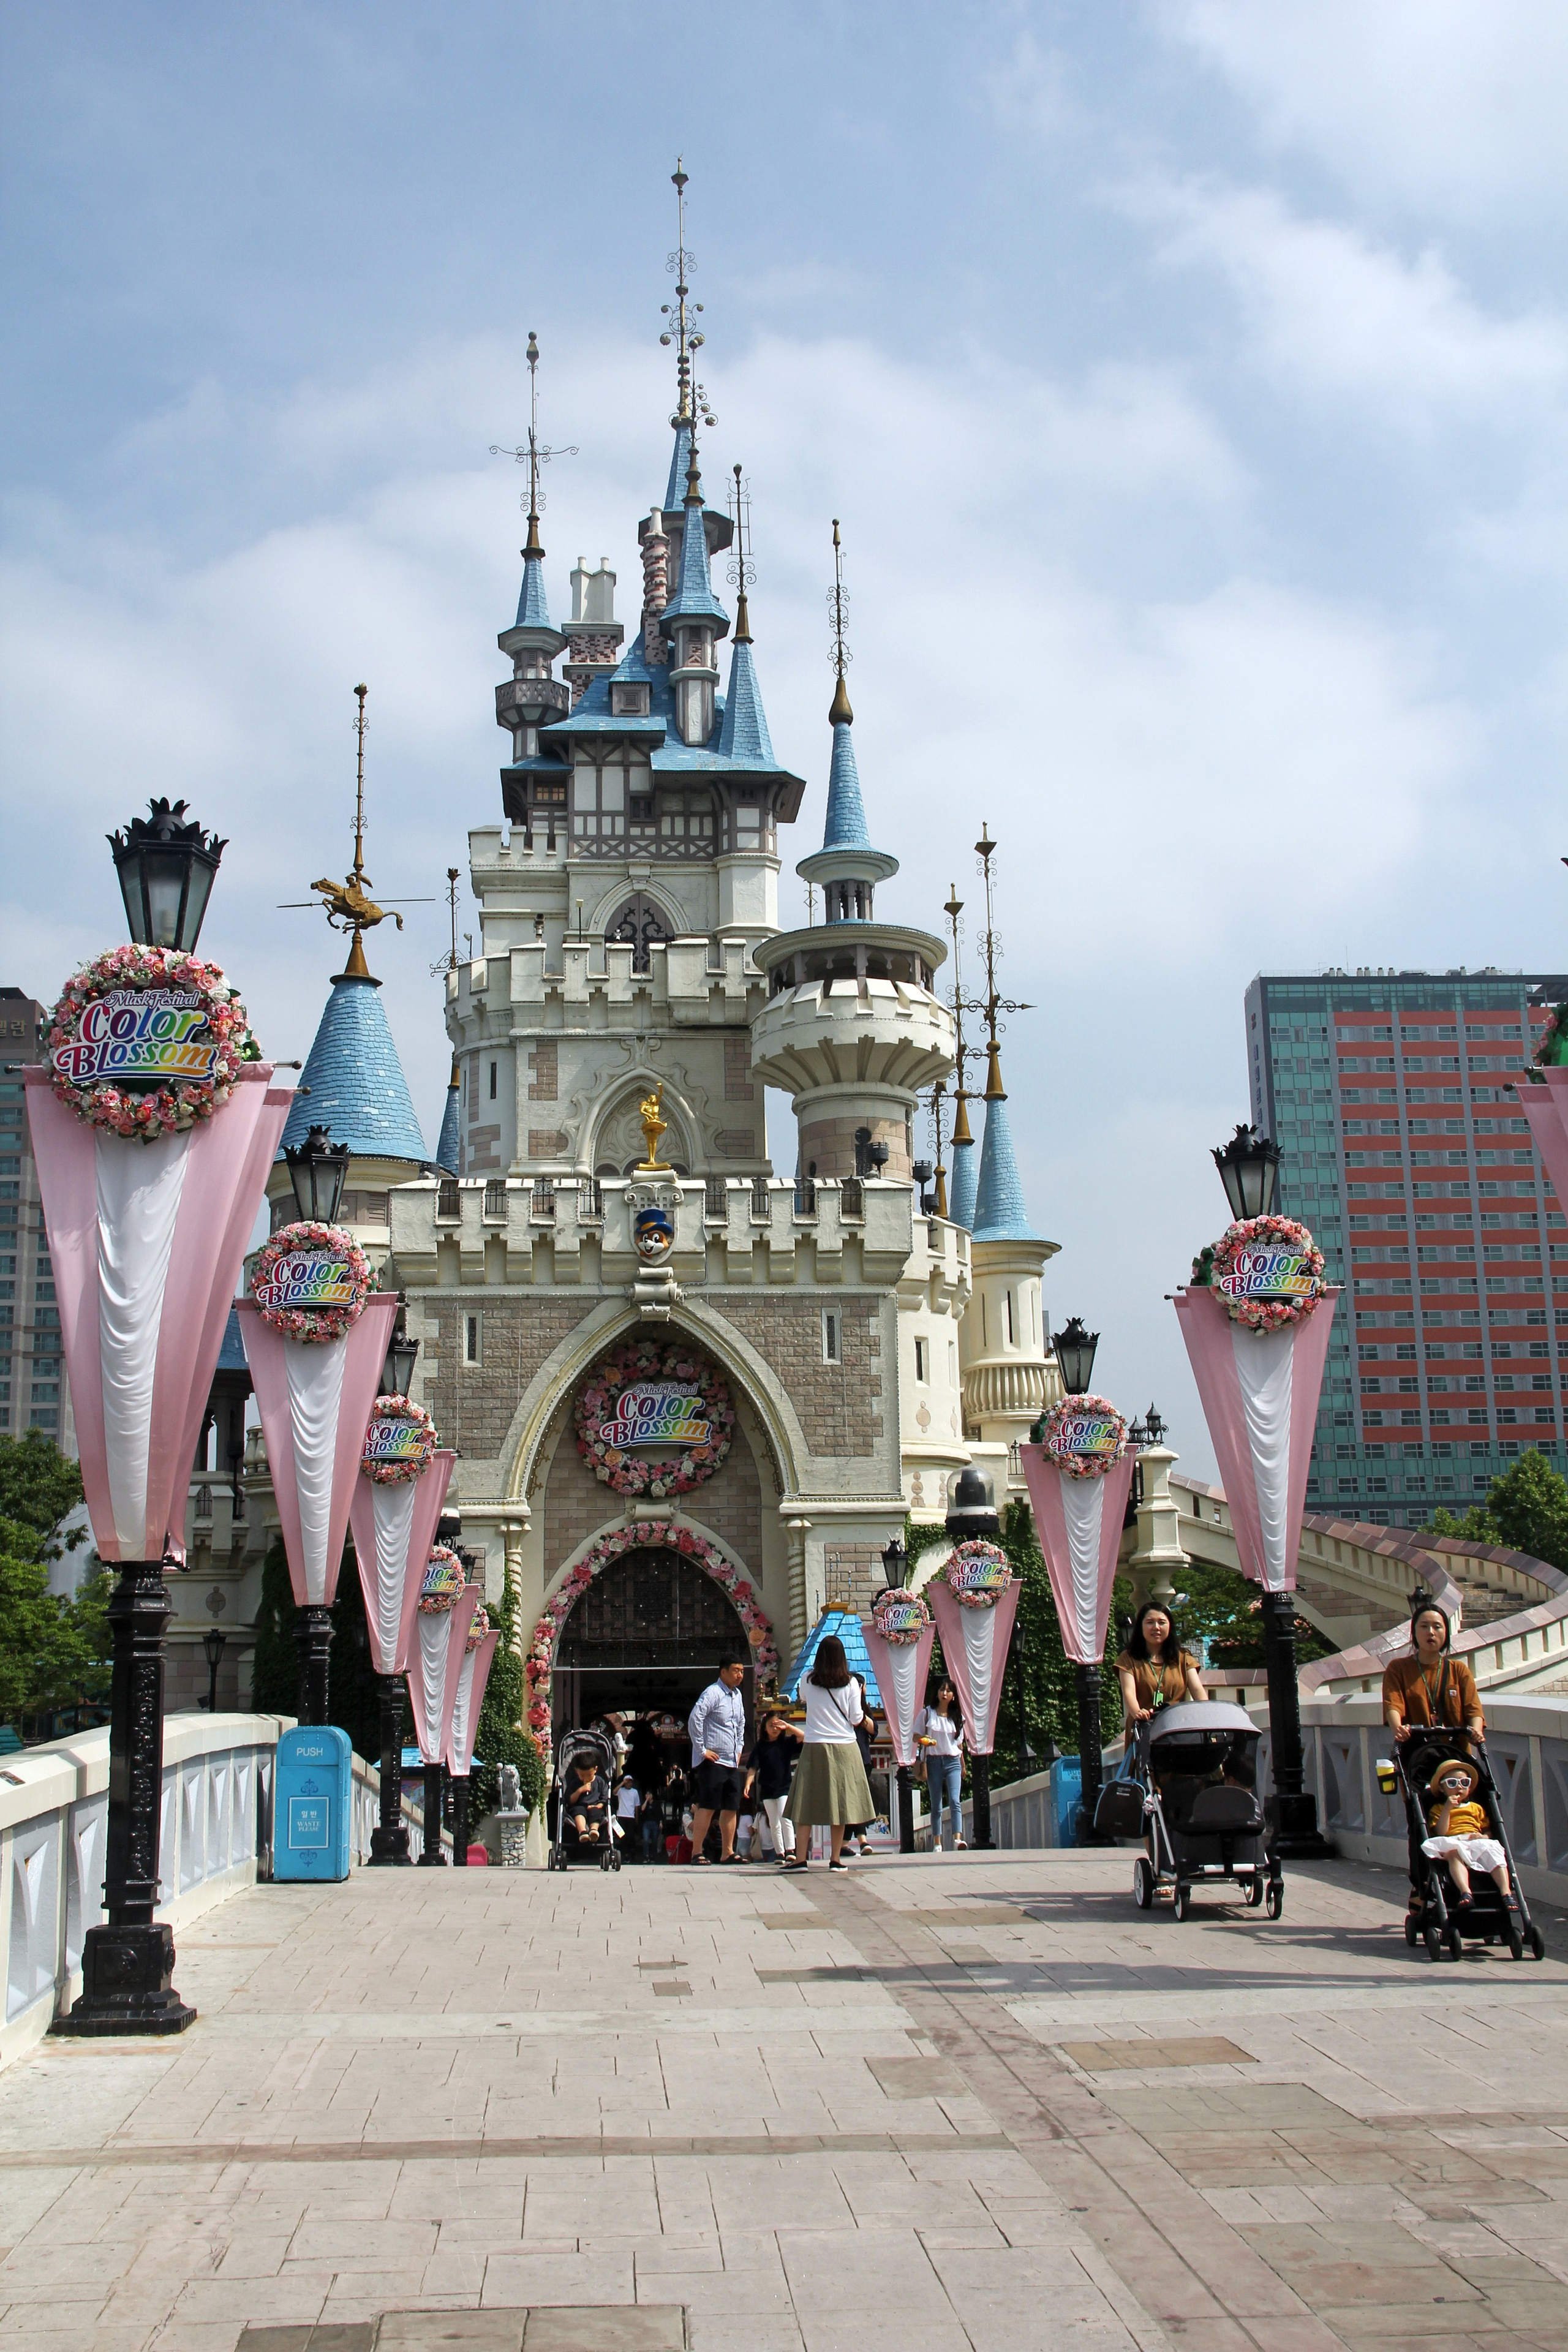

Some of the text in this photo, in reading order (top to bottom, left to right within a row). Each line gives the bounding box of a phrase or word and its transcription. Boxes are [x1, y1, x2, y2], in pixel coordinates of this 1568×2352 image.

[105, 990, 200, 1009] Mask Festival
[82, 1001, 209, 1042] Color
[287, 1251, 345, 1262] Mask Festival
[1247, 1244, 1303, 1254] Mask Festival
[1235, 1251, 1308, 1275] Color
[274, 1259, 350, 1284] Color
[633, 1383, 698, 1395] Mask Festival
[618, 1392, 704, 1420] Color
[368, 1423, 423, 1442] Color
[1061, 1420, 1114, 1438] Color
[960, 1562, 1001, 1575] Color
[423, 1580, 458, 1592] ossom
[884, 1608, 919, 1619] Color
[296, 1747, 323, 1756] PUSH
